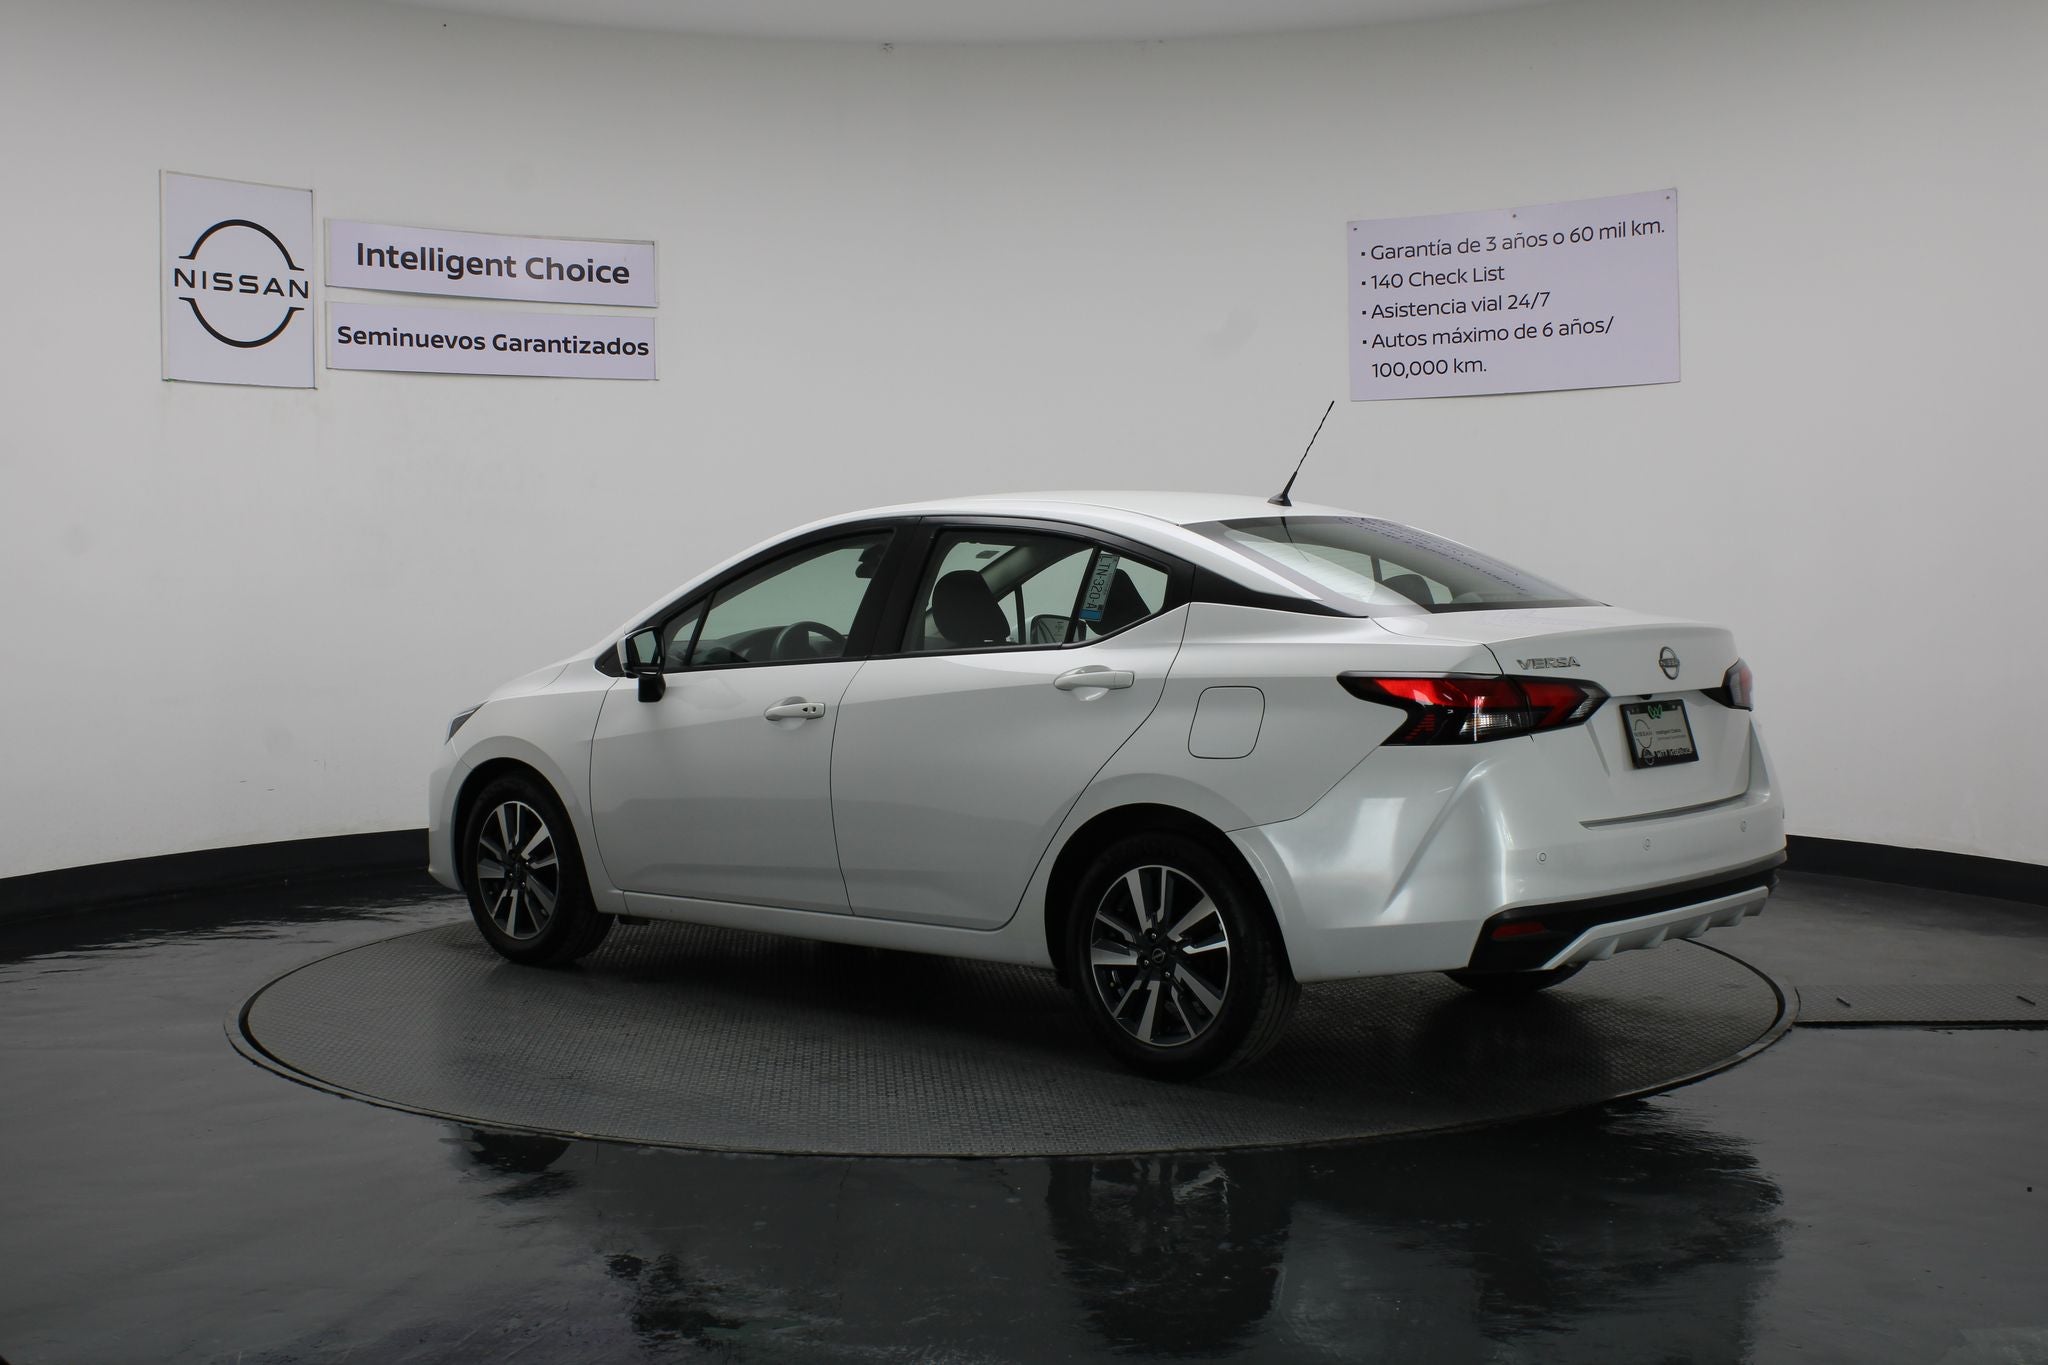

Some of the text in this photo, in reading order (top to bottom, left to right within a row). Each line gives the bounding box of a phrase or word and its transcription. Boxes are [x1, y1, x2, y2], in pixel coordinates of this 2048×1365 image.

[1371, 220, 1665, 261] Garantía de 3 años o 60 mil km.
[357, 243, 630, 285] Intelligent Choice
[1371, 265, 1506, 290] 140 Check List
[174, 267, 309, 299] NISSAN
[1371, 291, 1551, 320] Asistencia vial 24/7
[337, 326, 650, 357] Seminuevos Garantizados
[1371, 315, 1615, 349] Autos máximo de 6 años/
[1371, 357, 1488, 380] 100,000 km.
[1516, 656, 1581, 670] VERSA
